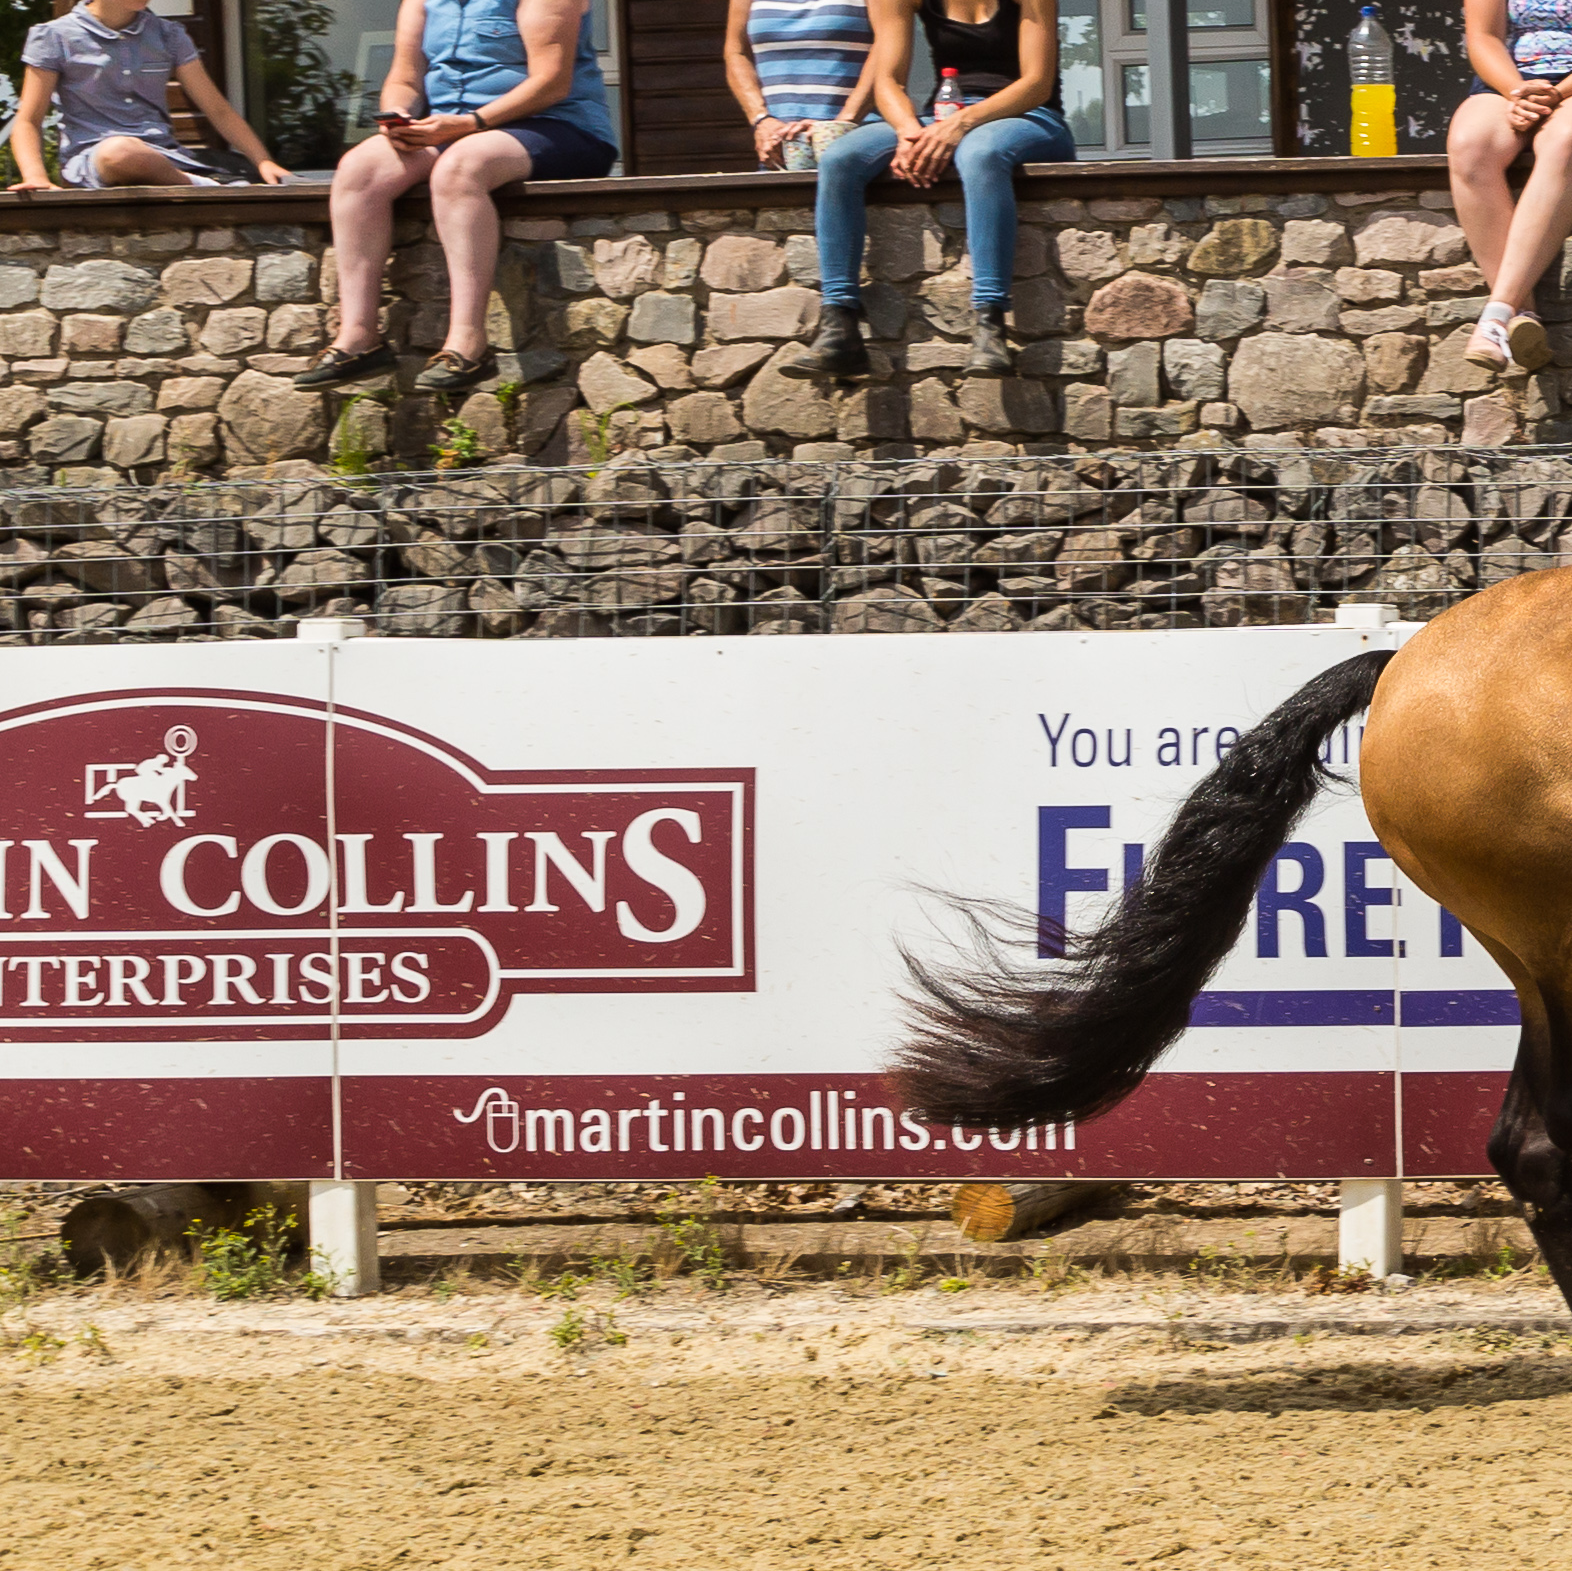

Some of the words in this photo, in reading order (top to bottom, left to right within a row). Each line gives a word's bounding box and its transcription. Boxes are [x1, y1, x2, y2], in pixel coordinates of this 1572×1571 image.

[1037, 712, 1133, 768] You
[1156, 725, 1241, 768] are
[159, 807, 707, 945] COLLINS
[0, 951, 430, 1009] TERPRISES
